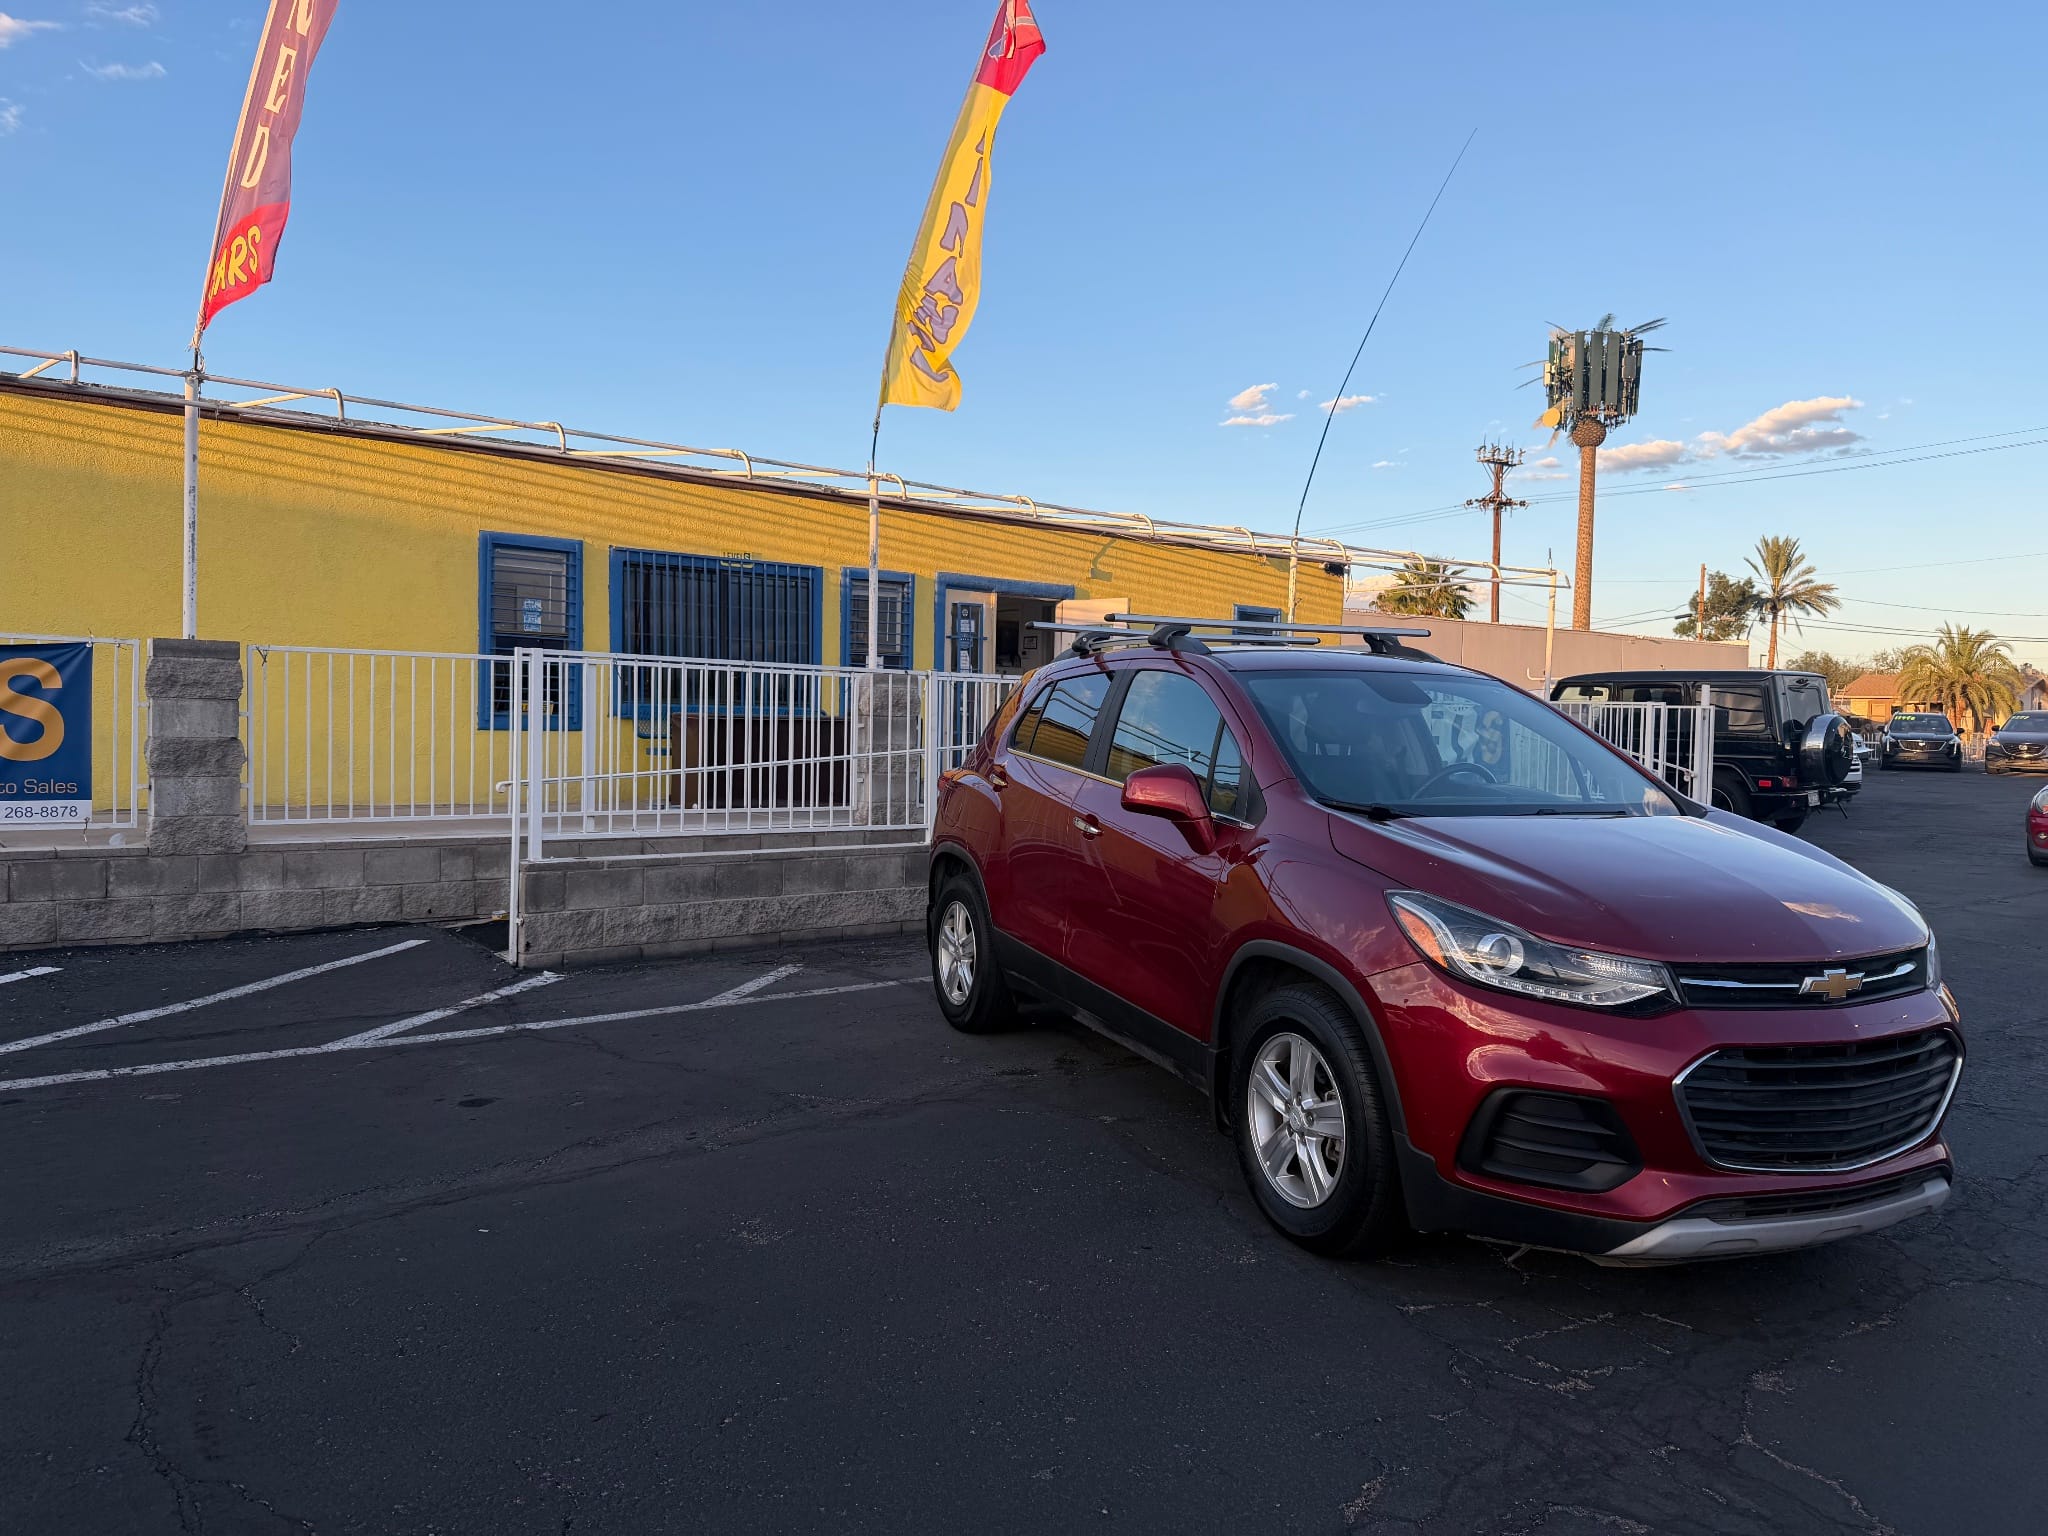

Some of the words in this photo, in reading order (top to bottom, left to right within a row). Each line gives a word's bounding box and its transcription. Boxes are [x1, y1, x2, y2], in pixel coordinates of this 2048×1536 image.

[208, 224, 262, 302] ARS
[23, 778, 78, 794] Sales
[4, 805, 78, 819] 268-8878
